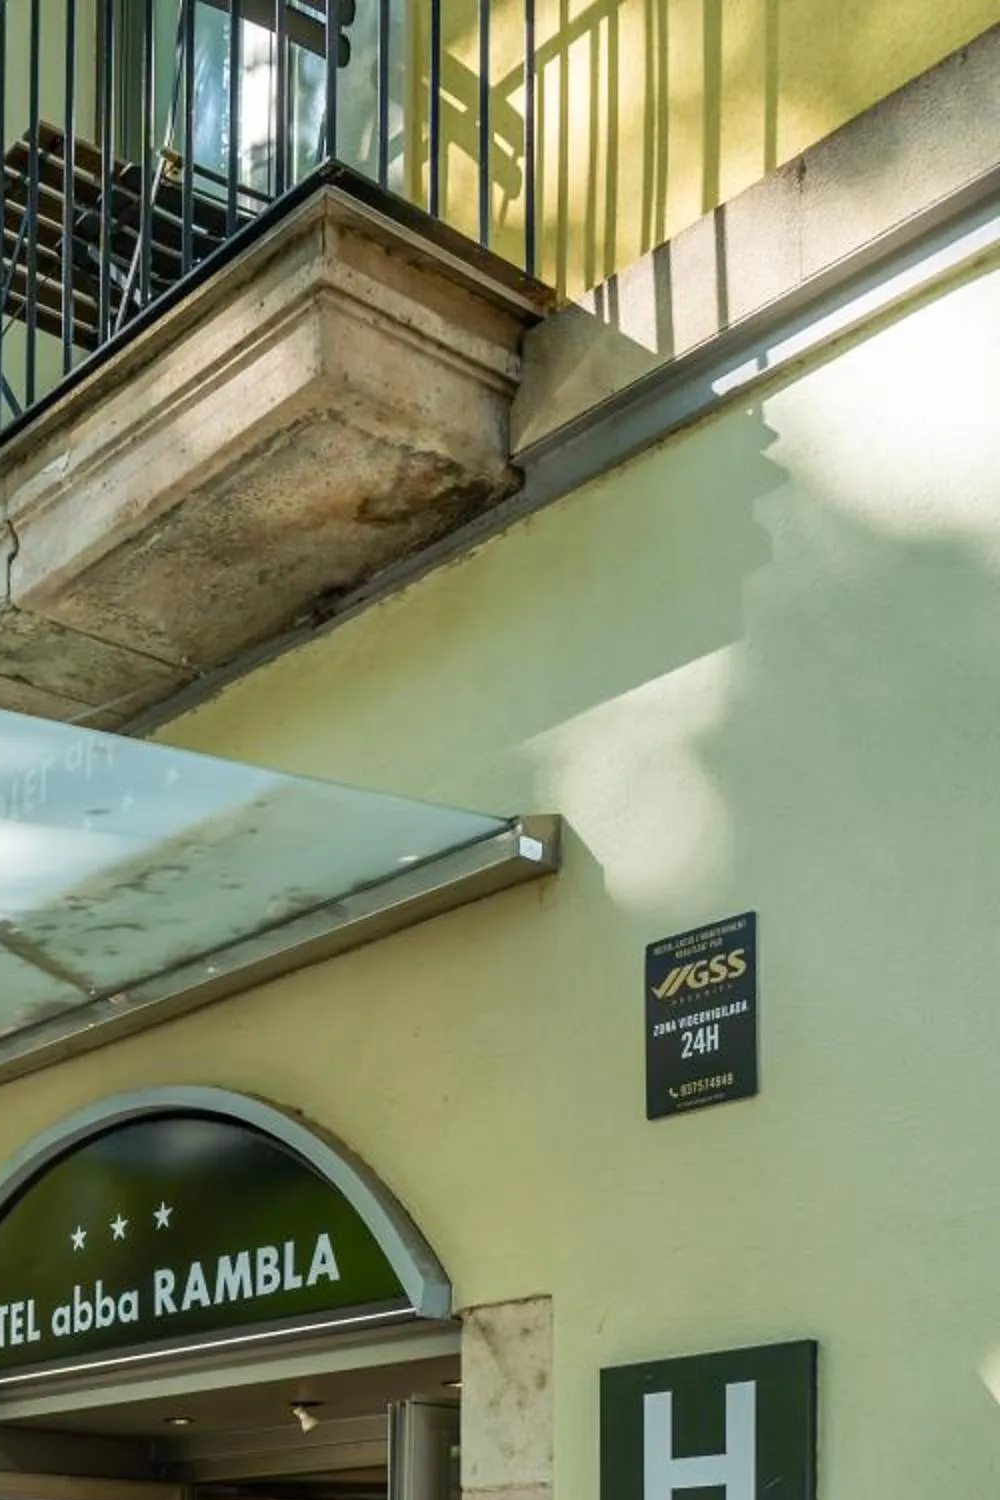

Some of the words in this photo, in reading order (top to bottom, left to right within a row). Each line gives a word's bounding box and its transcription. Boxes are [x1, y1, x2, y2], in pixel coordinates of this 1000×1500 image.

[686, 948, 747, 989] GSS
[681, 1023, 719, 1059] 24H
[50, 1279, 140, 1337] abba
[152, 1232, 342, 1318] RAMBLA
